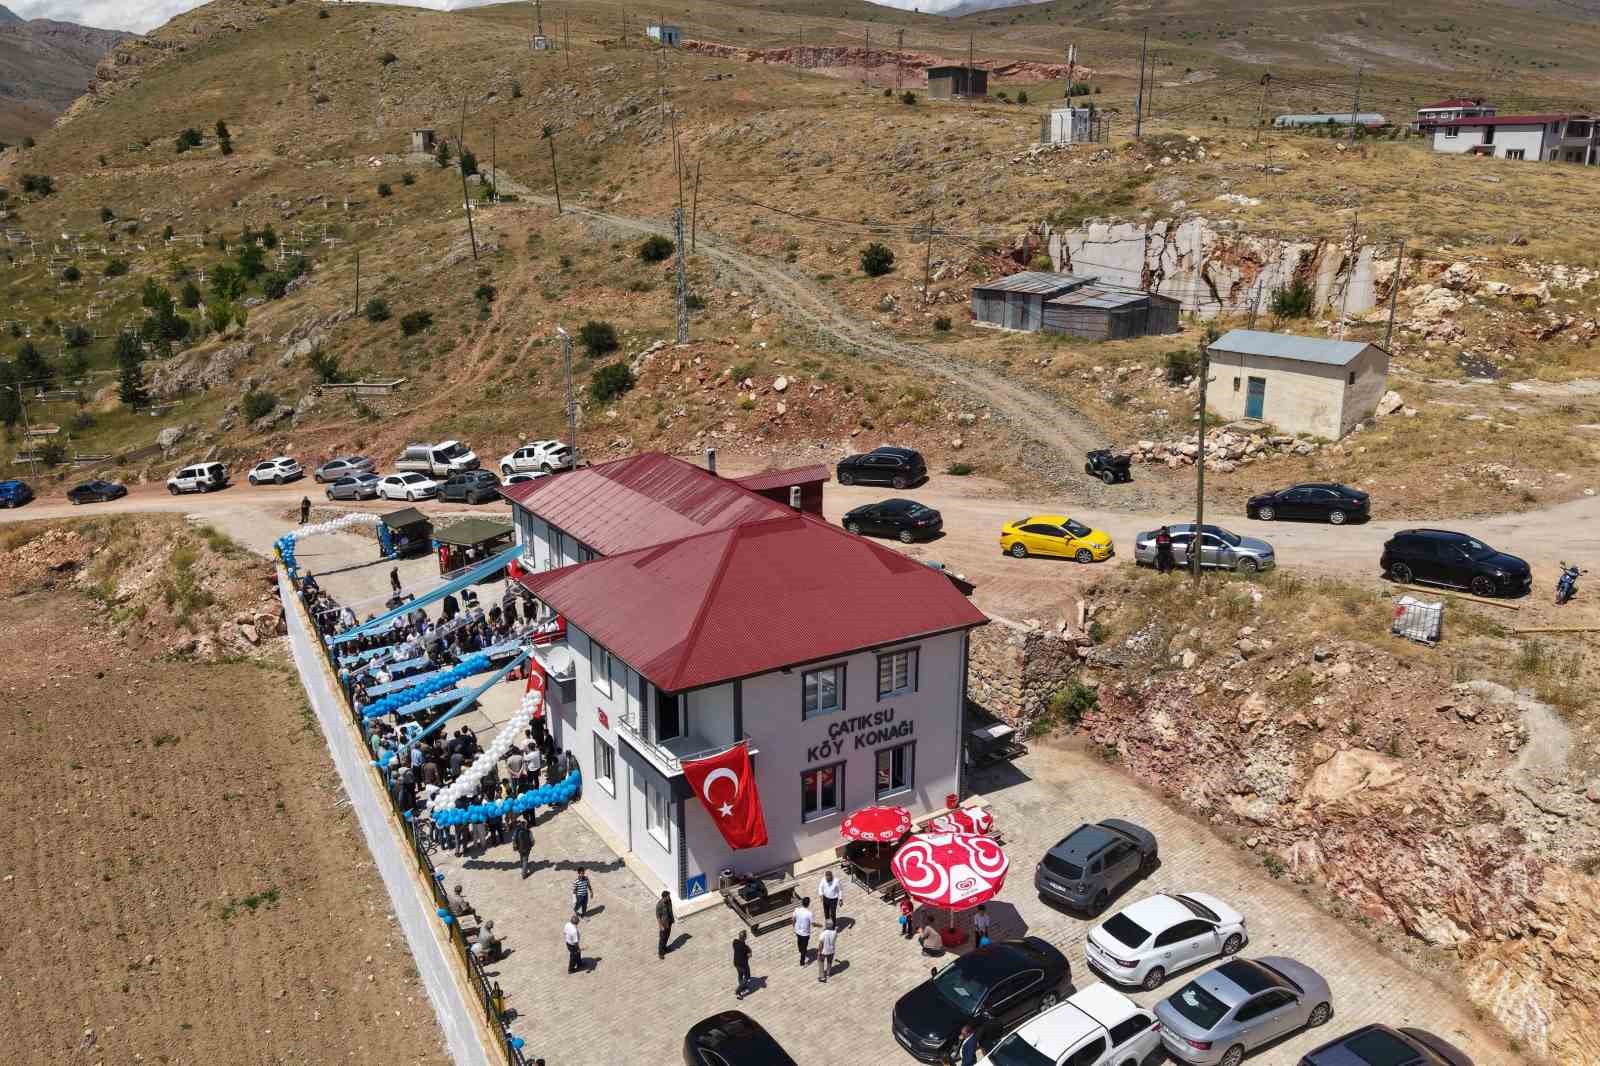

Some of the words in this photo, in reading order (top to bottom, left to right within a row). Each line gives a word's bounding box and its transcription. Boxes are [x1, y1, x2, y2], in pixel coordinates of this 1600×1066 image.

[808, 739, 844, 762] KÖY
[854, 720, 914, 750] KONAĞI
[828, 708, 894, 740] ÇATIKSU
